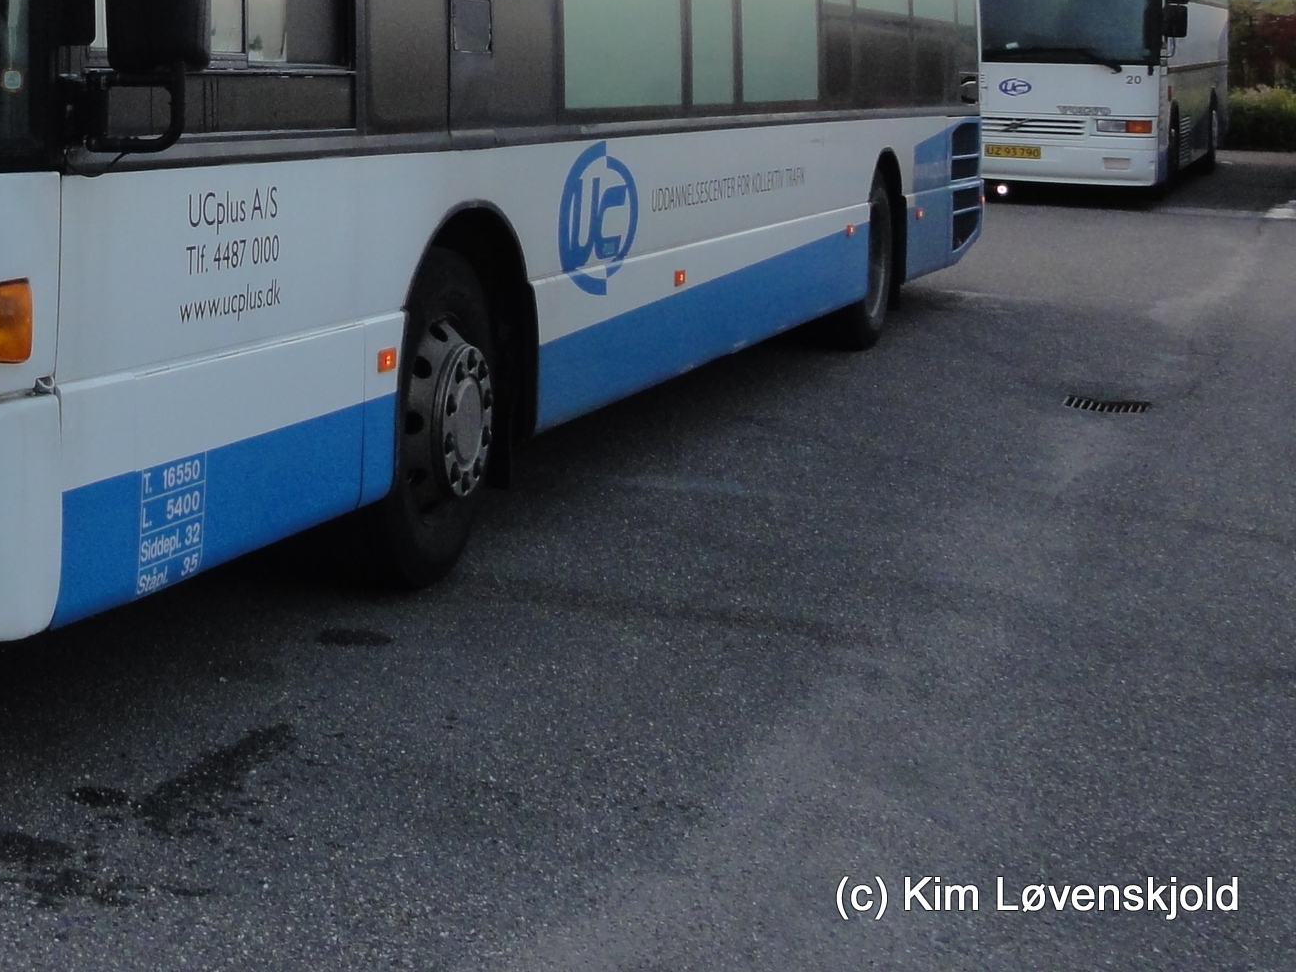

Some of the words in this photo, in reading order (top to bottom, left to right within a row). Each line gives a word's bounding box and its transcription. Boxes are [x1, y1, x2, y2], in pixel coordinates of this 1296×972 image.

[1125, 75, 1142, 85] 20
[188, 190, 246, 235] UCplus
[250, 185, 278, 221] A/S
[651, 177, 736, 213] UDDANNELSESCENTER
[572, 177, 627, 260] UC
[185, 243, 209, 276] Tlf.
[213, 238, 247, 271] 4487
[251, 234, 280, 265] 0100
[179, 278, 281, 324] www.ucplus.dk
[143, 472, 153, 495] T.
[162, 459, 201, 490] 16550
[142, 507, 153, 528] L.
[166, 490, 201, 520] 5400
[140, 528, 182, 562] Siddepl.
[184, 522, 200, 546] 32
[181, 552, 199, 576] 35
